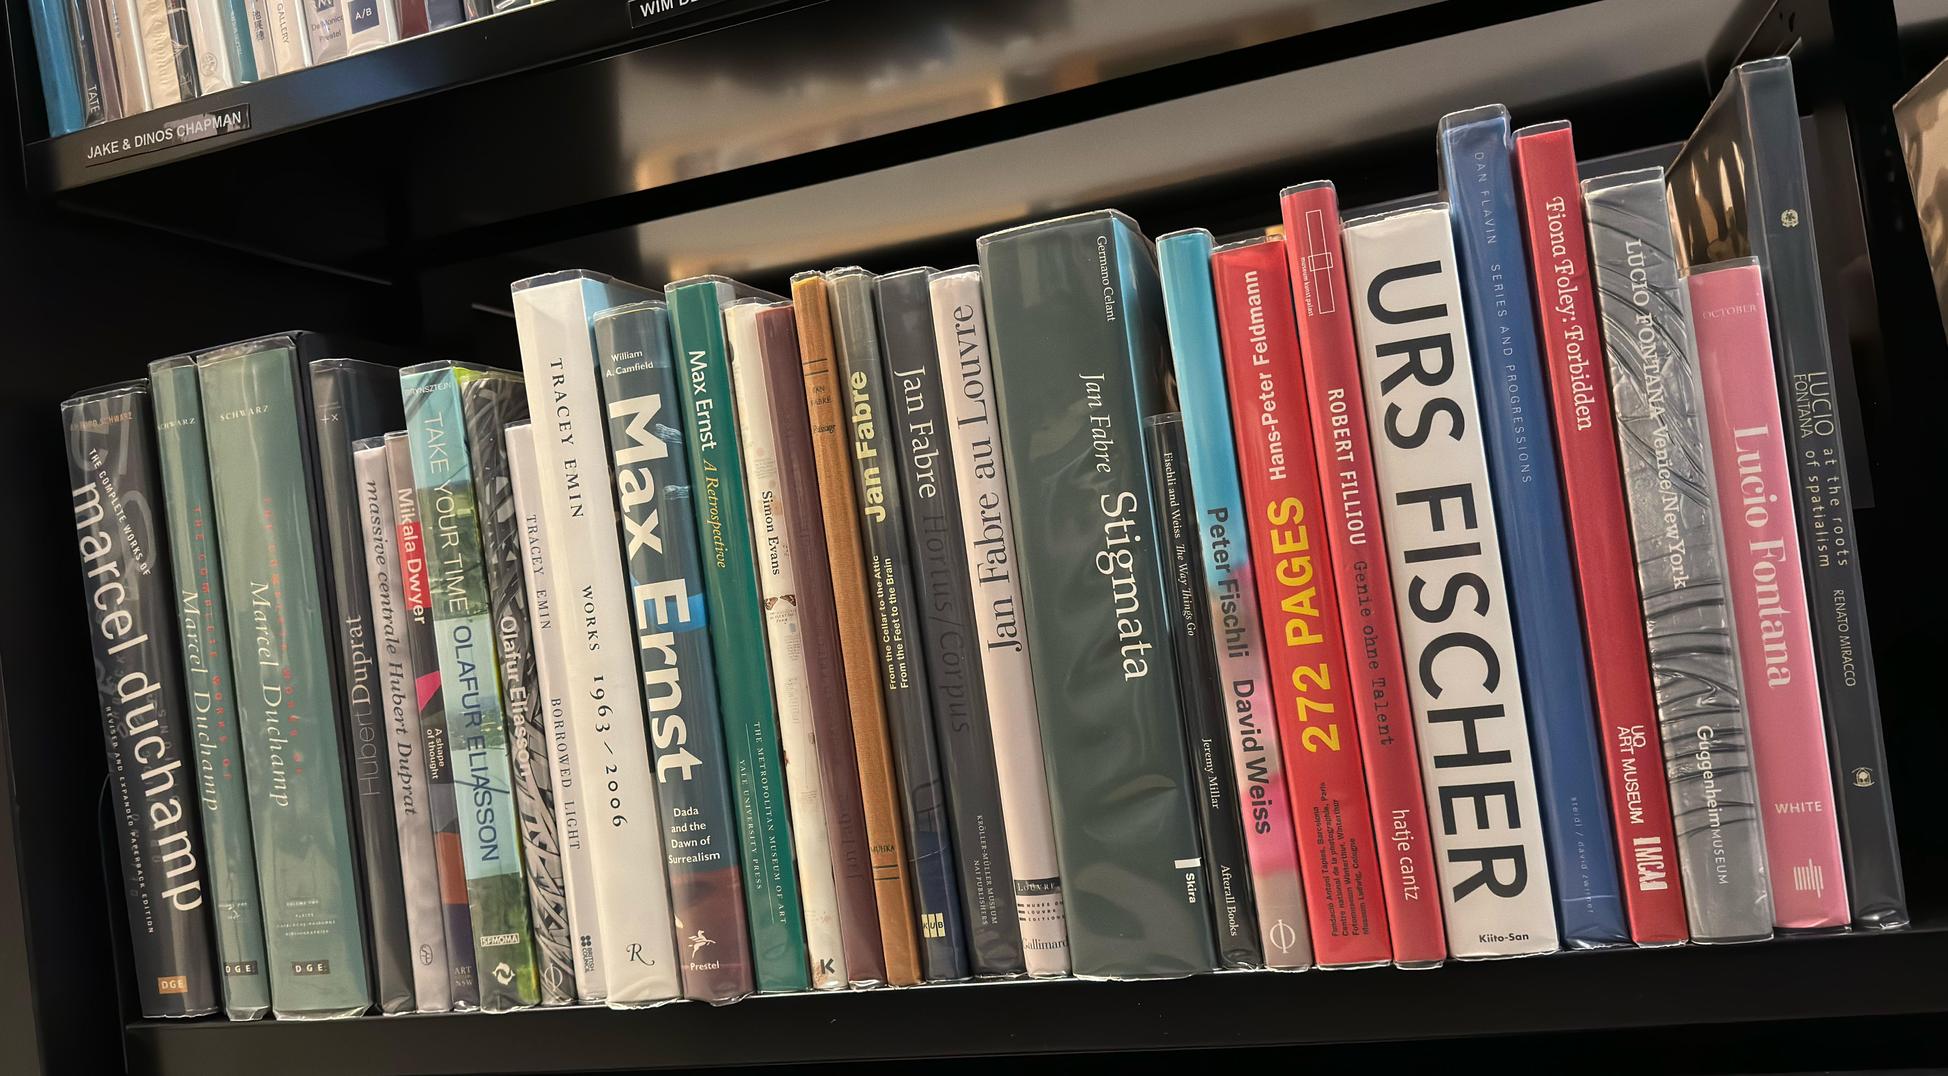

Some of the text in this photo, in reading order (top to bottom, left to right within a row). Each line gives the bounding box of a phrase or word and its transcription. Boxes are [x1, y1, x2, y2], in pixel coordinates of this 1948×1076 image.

[277, 3, 290, 44] GALLERY
[87, 84, 101, 114] TATE
[87, 111, 242, 160] JAKE & DINOS CHAPMAN
[1096, 235, 1116, 322] Germano Celant
[1474, 151, 1533, 484] DAN FLAVIN SERIES AND PROGRESSIONS
[1545, 196, 1596, 431] Fiona Foley: Forbidden
[1625, 238, 1666, 421] LUCIO FONTANA
[605, 361, 655, 379] A. Camfield
[610, 350, 643, 363] William
[423, 411, 450, 474] TAKE
[688, 350, 730, 570] Max Ernst Retrospective
[850, 370, 887, 523] Jan Fabre
[893, 364, 941, 499] Jan Fabre
[953, 303, 1023, 653] Jan Fabre au Louvre
[1793, 374, 1831, 568] FONTANA of spatialism
[88, 447, 152, 577] THE COMPLETE WORKS OF
[397, 487, 426, 625] Mikala Dwyer
[433, 479, 461, 550] YOUR
[549, 357, 600, 652] TRACEY EMIN WORKS
[761, 490, 774, 533] Simon
[767, 535, 780, 577] Evans
[1079, 373, 1153, 682] Jan Fabre Stigmata
[1244, 270, 1341, 753] 272 PAGES Hans-Peter Feldmann
[1733, 424, 1792, 689] Lucio Fontana
[1807, 371, 1857, 688] LUCIO at the roots RENATO MIRACCO
[72, 481, 149, 656] marcel
[442, 552, 469, 614] TIME
[608, 393, 704, 784] Max Ernst
[872, 555, 897, 690] From the Cellar to the Attic
[883, 558, 909, 689] From the Feet to the Brain
[1327, 387, 1395, 746] ROBERT FILLIOU Genie Talent
[1366, 259, 1529, 904] URS FISCHER
[182, 589, 219, 811] Marcel Duchamp
[250, 581, 290, 807] Marcel Duchamp
[365, 479, 417, 816] massive centrale Hubert Duprat
[453, 625, 483, 728] OLAFUR
[499, 616, 522, 684] Olafur
[526, 514, 581, 850] TRACEY EMIN BORROWED LIGHT
[1163, 452, 1238, 937] Fischli and Weiss The Way Things Go Jeremy Millar Afterall Books
[1206, 507, 1273, 835] Peter Fischli David Weiss
[114, 752, 124, 772] AND
[345, 615, 381, 797] Hubert Duprat
[426, 729, 440, 780] of thought
[434, 728, 445, 768] A shape
[117, 671, 203, 911] duchamp
[467, 735, 500, 863] ELIASSON
[670, 821, 707, 833] and the
[672, 807, 700, 818] Dada
[739, 759, 762, 890] YALE PRESS
[753, 721, 787, 925] THE METROPOLITAN MUSEUM OF ART
[1617, 725, 1645, 825] ART MUSEUM
[1775, 800, 1823, 815] WHITE
[668, 851, 721, 865] Surrealism
[671, 836, 711, 849] Dawn of
[1185, 872, 1196, 904] Skira
[1391, 808, 1419, 902] hatje cantz
[481, 934, 519, 947] SFMOMA
[923, 921, 944, 930] KUB
[987, 887, 998, 925] MUSEUM
[1478, 931, 1530, 945] Kiito-San
[161, 978, 185, 990] DGE
[224, 964, 252, 974] DGE
[295, 963, 324, 973] DGE
[690, 960, 720, 971] Prestel
